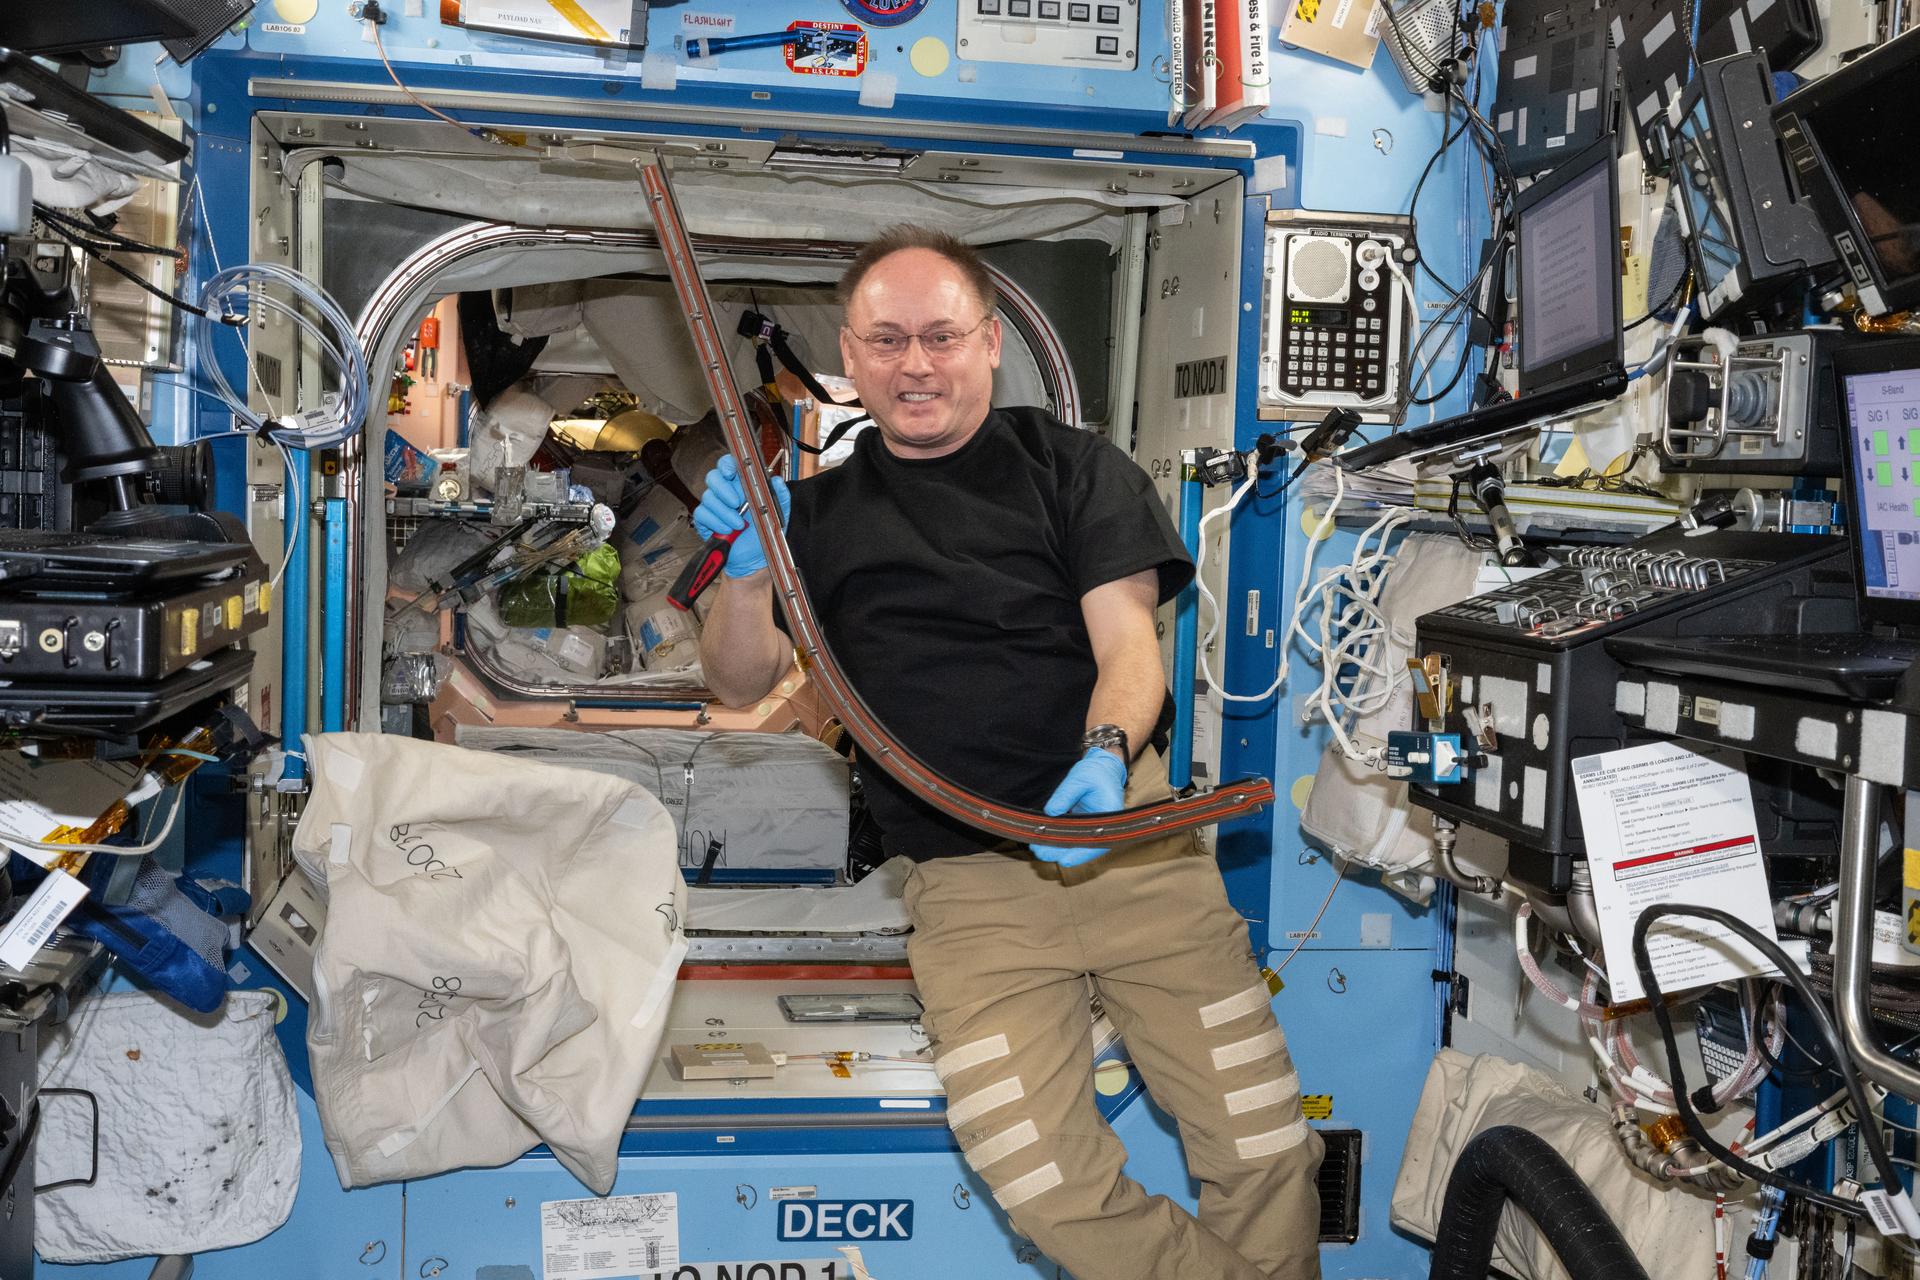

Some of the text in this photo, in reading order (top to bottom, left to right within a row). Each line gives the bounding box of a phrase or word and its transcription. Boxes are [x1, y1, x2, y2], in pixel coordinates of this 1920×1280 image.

[497, 13, 526, 23] PAYLOAD
[682, 14, 733, 28] FLASHLIGHT
[813, 22, 844, 30] DESTINY
[1173, 36, 1182, 96] COMPUTERS
[1176, 359, 1225, 397] TO NOD 1
[1882, 386, 1904, 395] S-Band
[1868, 410, 1883, 422] S/G
[1890, 502, 1909, 512] Health
[1582, 773, 1617, 784] ANNUNCIATED)
[665, 797, 683, 805] ZERO
[1674, 848, 1694, 856] WARNING
[784, 1204, 908, 1238] DECK
